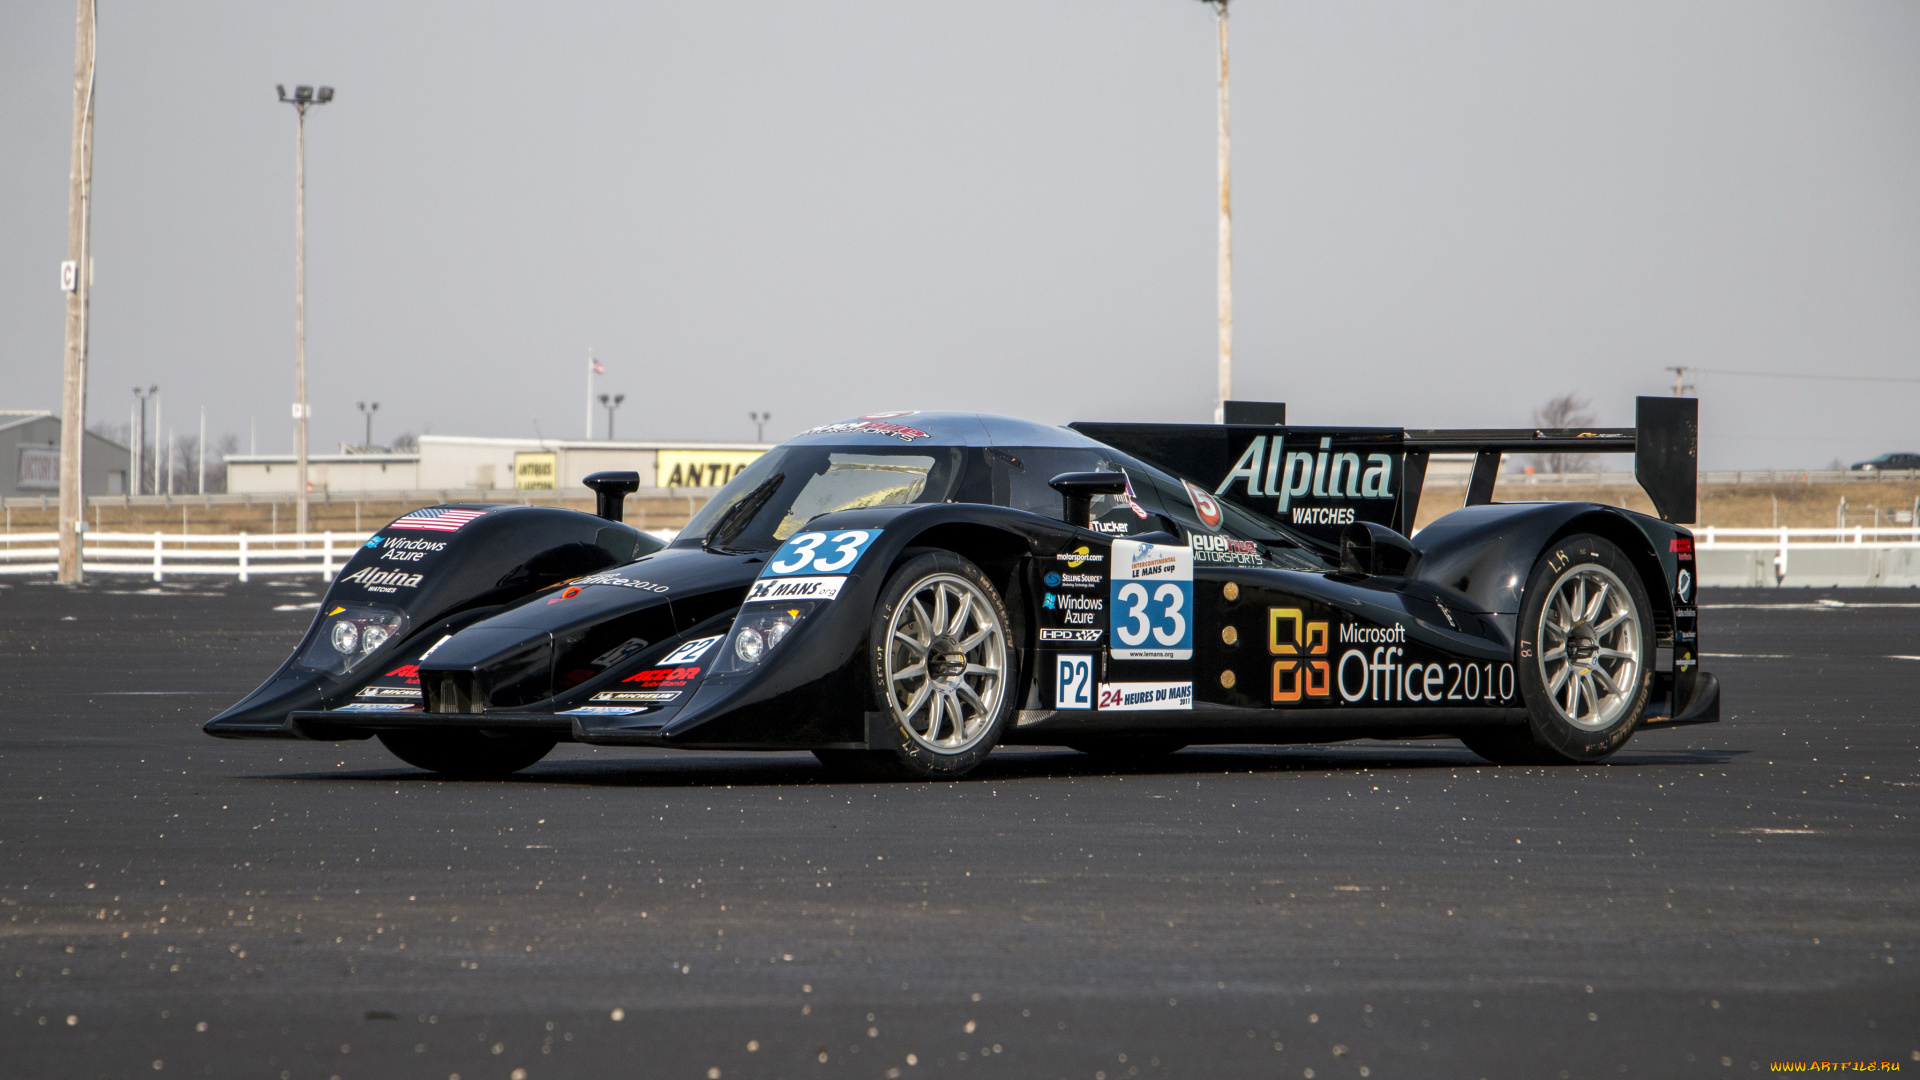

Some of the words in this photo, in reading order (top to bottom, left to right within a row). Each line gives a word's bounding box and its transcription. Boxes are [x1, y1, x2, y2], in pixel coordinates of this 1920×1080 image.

[63, 264, 72, 287] C
[518, 463, 552, 476] ANTIQUES
[1214, 435, 1395, 514] Alpina
[1190, 487, 1217, 516] 5
[1293, 508, 1355, 524] WATCHES
[1092, 521, 1128, 532] Tucker
[382, 537, 447, 551] Windows
[771, 530, 869, 574] 33
[380, 548, 424, 561] Azure
[1057, 553, 1102, 563] motorsport.com
[1193, 551, 1263, 565] MOTORSPORTS
[1131, 557, 1176, 569] INTERCONTINENTAL
[340, 566, 424, 588] Alpina
[1132, 570, 1140, 578] LE
[1141, 565, 1162, 576] MANS
[1163, 565, 1175, 573] cup
[1057, 594, 1103, 610] Windows
[1064, 609, 1094, 623] Azure
[1117, 582, 1186, 646] 33
[1043, 631, 1072, 639] HPD
[1340, 622, 1406, 643] Microsoft
[665, 638, 716, 662] P2
[621, 667, 701, 682] ACCOR
[1059, 661, 1088, 703] P2
[1100, 689, 1123, 708] 24
[1124, 691, 1154, 705] HEURES
[1155, 689, 1167, 701] DU
[1168, 685, 1191, 699] MANS
